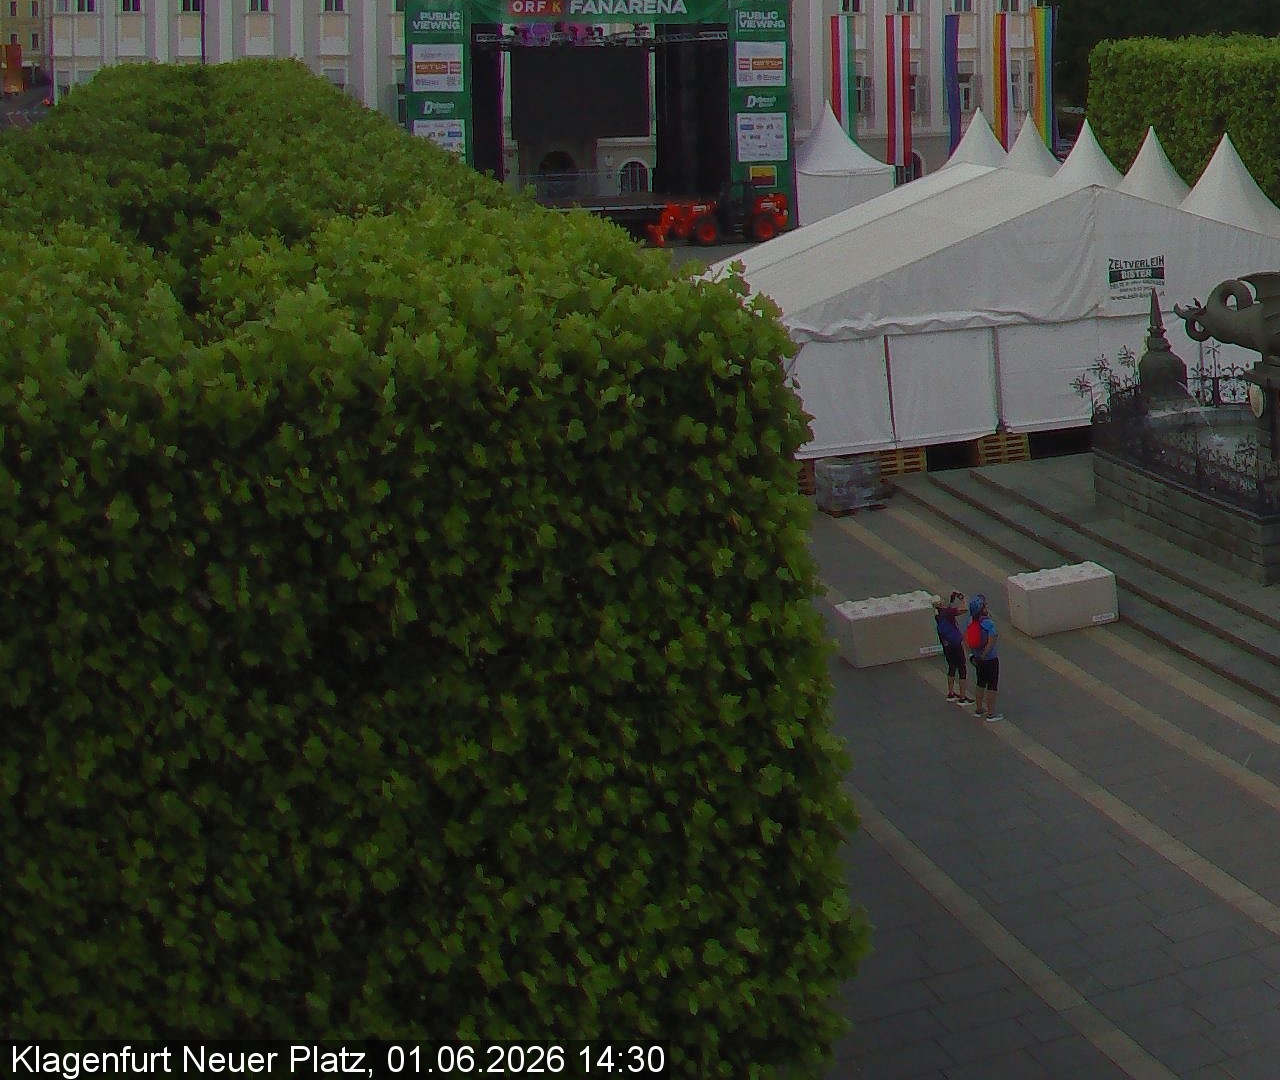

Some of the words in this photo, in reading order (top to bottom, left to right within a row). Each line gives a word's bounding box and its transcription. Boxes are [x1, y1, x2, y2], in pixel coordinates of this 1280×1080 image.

[512, 0, 547, 13] ORF
[569, 0, 688, 15] FANARENA
[419, 11, 461, 21] PUBLIC
[738, 10, 779, 20] PUBLIC
[412, 20, 461, 30] VIEWING
[738, 19, 786, 29] VIEWING
[1109, 255, 1165, 271] ZELTVERLEIH
